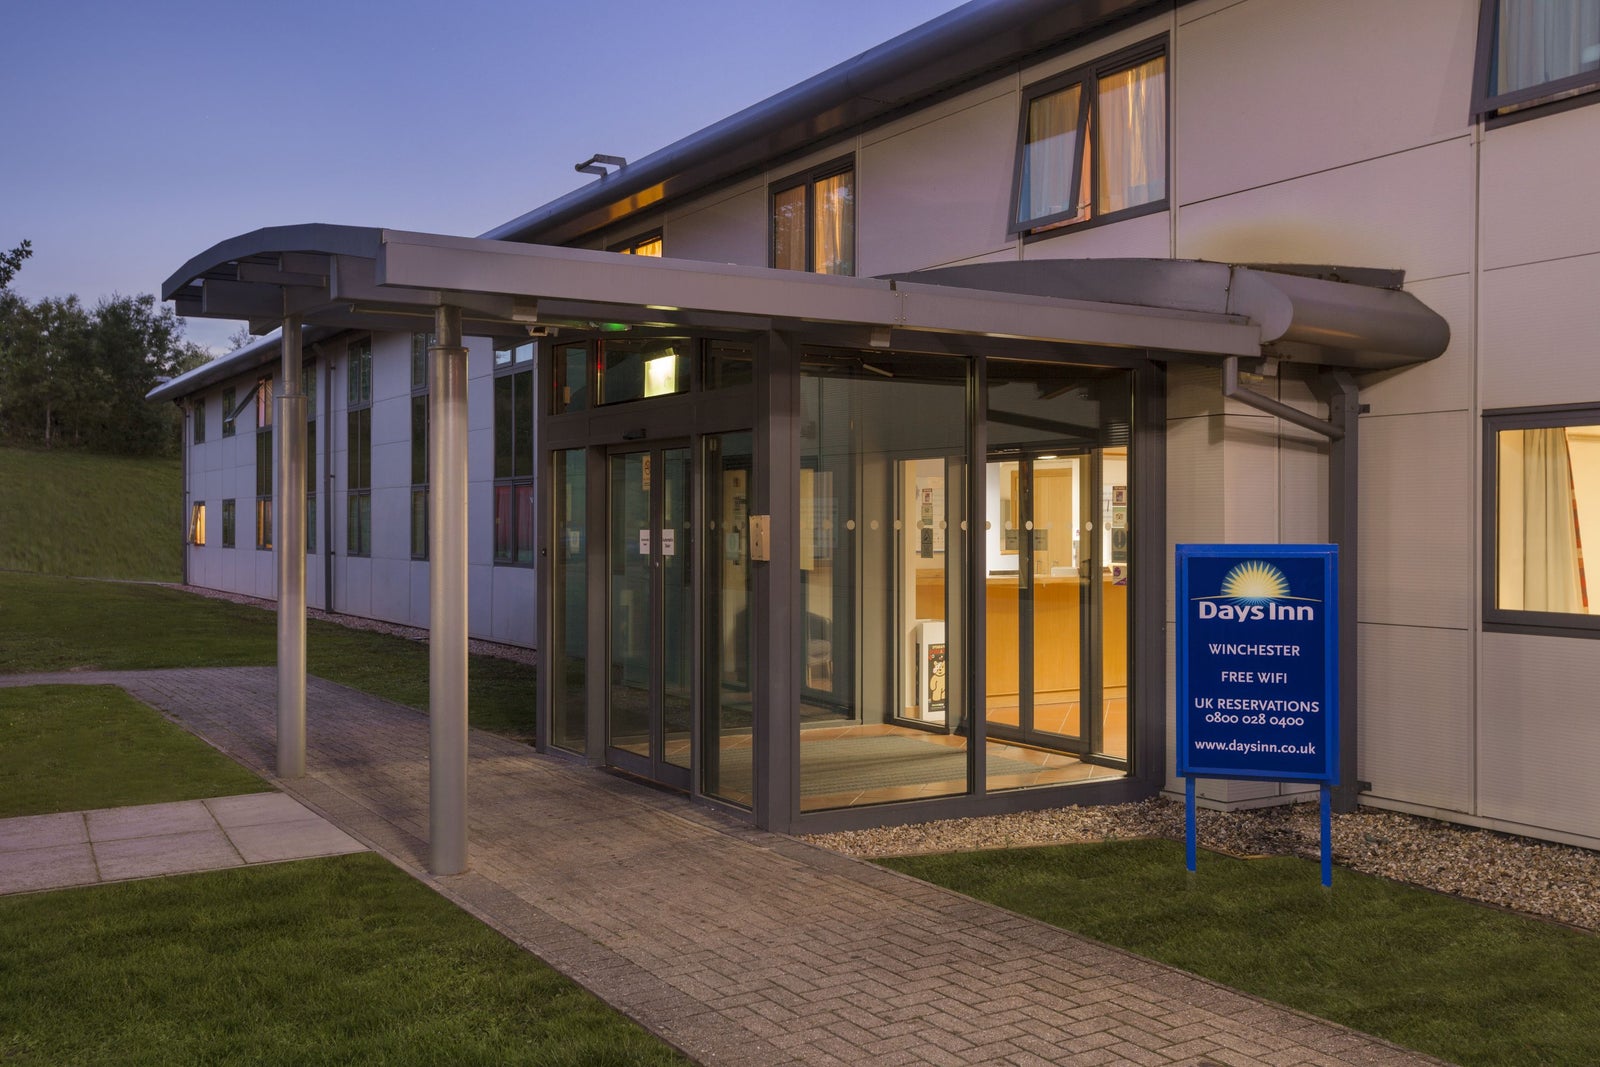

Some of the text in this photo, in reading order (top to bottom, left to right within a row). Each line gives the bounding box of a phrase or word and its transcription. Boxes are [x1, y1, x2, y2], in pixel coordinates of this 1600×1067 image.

[1199, 601, 1314, 622] Days Inn
[1208, 643, 1300, 657] WINCHESTER
[1221, 671, 1287, 684] FREE WIFI
[1194, 697, 1320, 713] UK RESERVATIONS
[1205, 712, 1305, 729] 0800 028 0400
[1194, 738, 1316, 755] www.daysinn.co.uk
